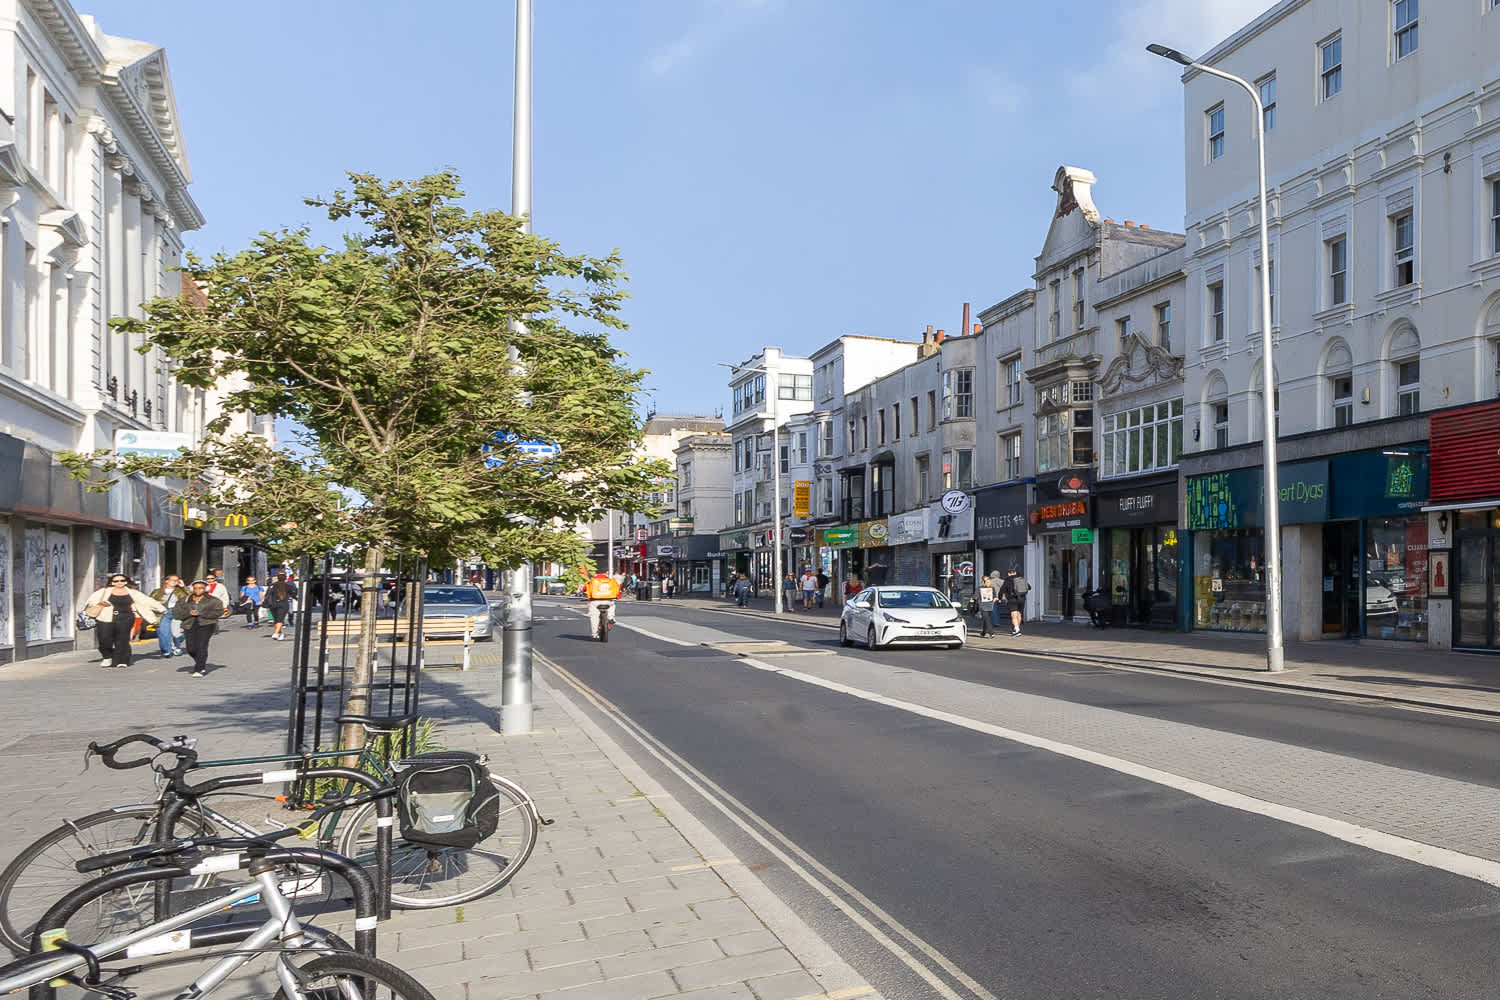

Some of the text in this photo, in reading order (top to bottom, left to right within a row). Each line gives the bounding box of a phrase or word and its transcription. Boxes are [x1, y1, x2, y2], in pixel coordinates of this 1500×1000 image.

[1296, 481, 1324, 503] Dyas
[1120, 495, 1153, 511] FLUFFY FLUFFY
[978, 513, 1011, 529] MARTLETS
